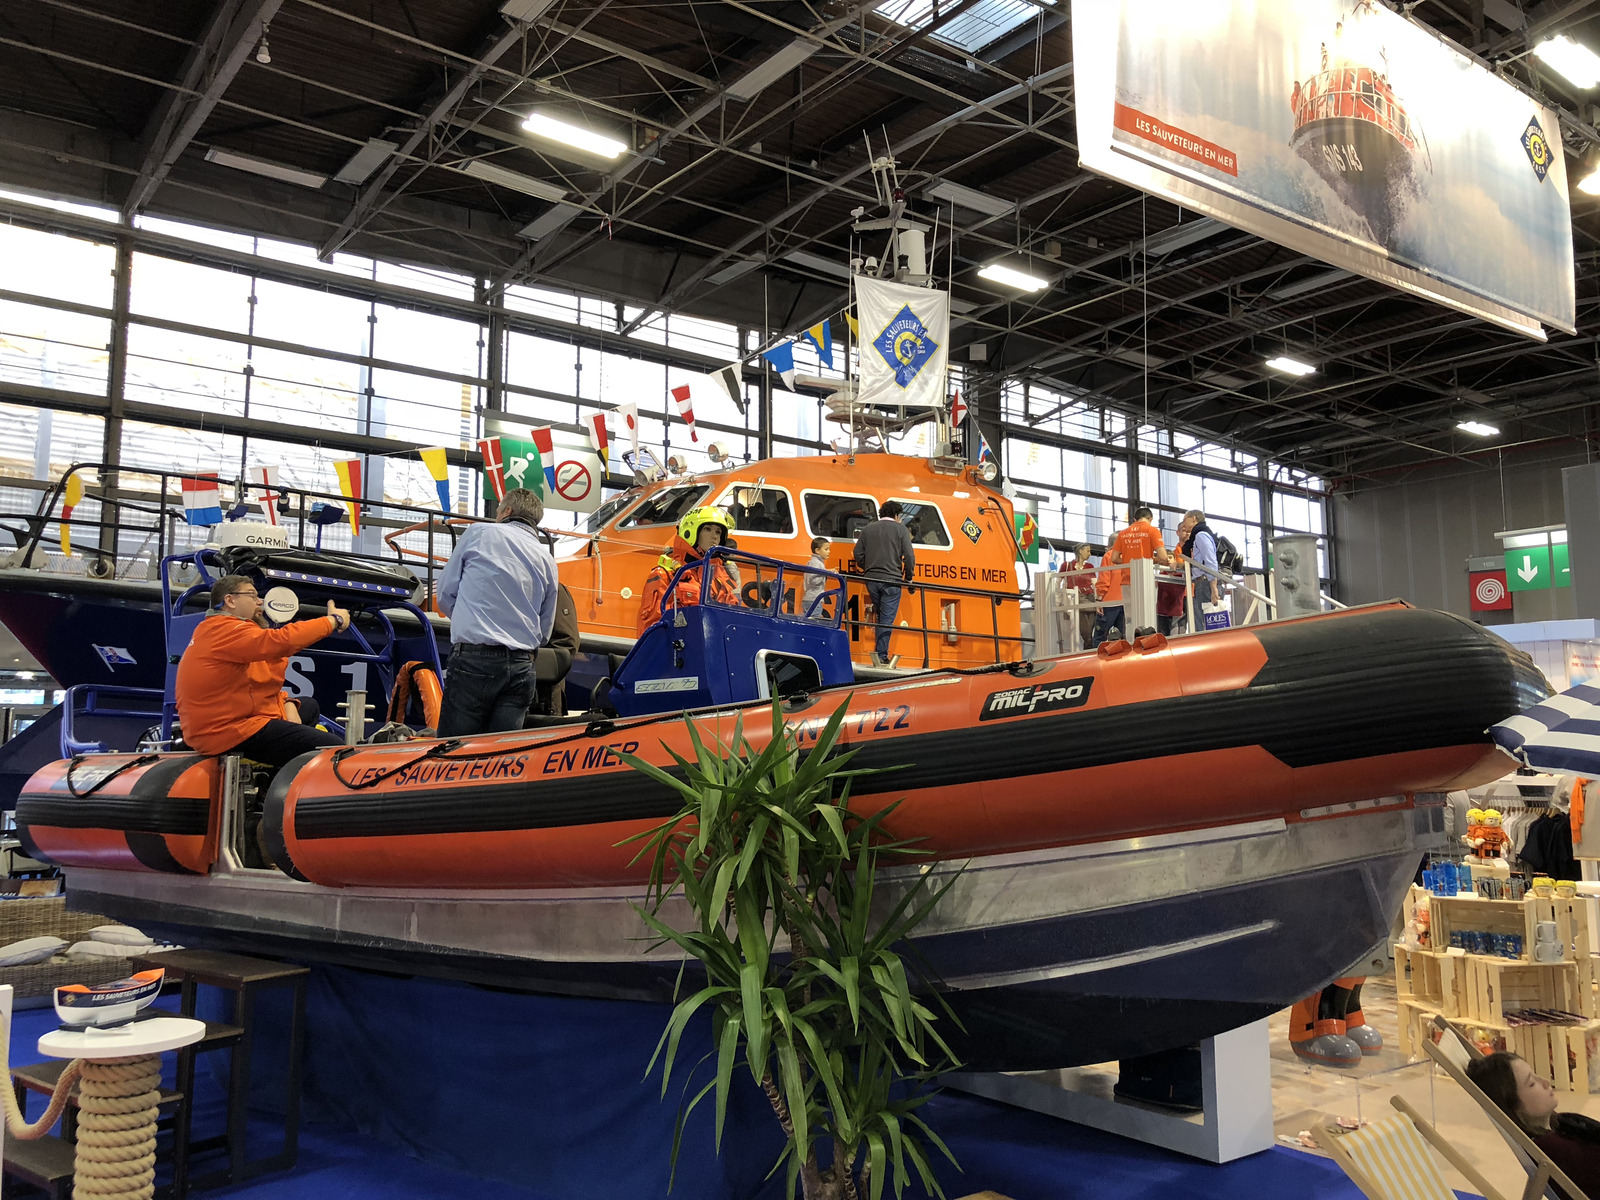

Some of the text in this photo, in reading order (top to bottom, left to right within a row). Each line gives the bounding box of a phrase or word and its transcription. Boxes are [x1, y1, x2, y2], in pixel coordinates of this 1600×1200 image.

[1136, 118, 1234, 169] LES SAUVETEURS EN MER
[886, 320, 920, 339] SAUVETEURS
[885, 340, 893, 353] LES
[246, 535, 289, 548] GARMIN
[960, 566, 976, 581] EN
[982, 569, 1007, 583] MER
[989, 685, 1084, 713] MILPRO
[994, 687, 1032, 699] ZODIAC
[856, 704, 910, 735] 722
[394, 754, 530, 787] SAUVETEURS
[543, 749, 579, 774] EN
[581, 741, 640, 770] MER
[104, 988, 140, 1000] SAUVETEURS
